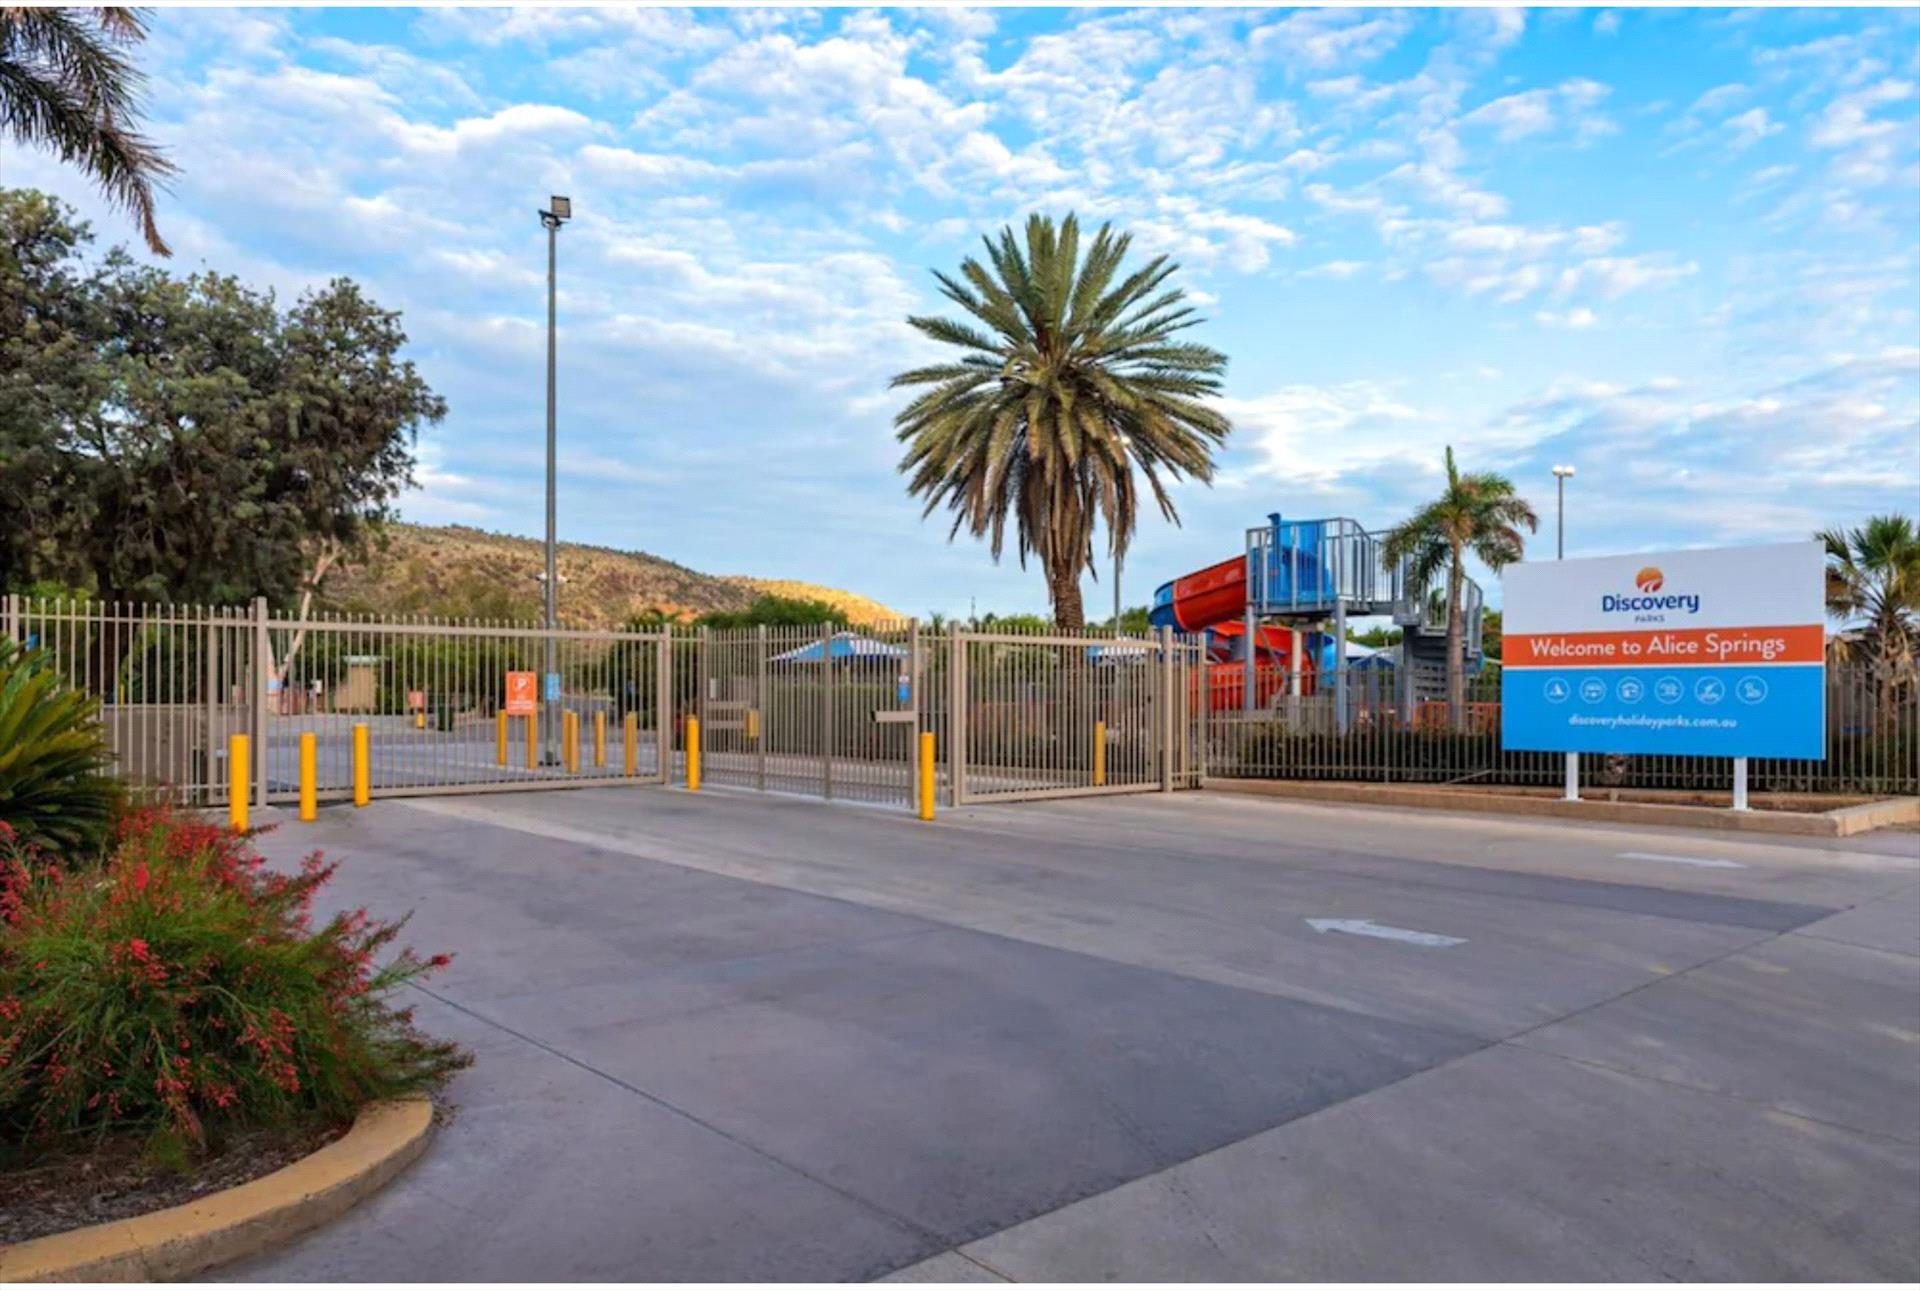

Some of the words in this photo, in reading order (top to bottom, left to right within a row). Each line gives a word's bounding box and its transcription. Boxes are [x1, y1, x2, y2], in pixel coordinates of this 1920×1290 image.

[1602, 593, 1700, 614] Discovery
[1634, 614, 1665, 623] PARKS
[1530, 637, 1615, 657] Welcome
[1621, 639, 1641, 656] to
[1647, 635, 1698, 655] Alice
[1705, 633, 1786, 660] Springs
[1568, 713, 1737, 730] discoveryholidayparks.com.au
